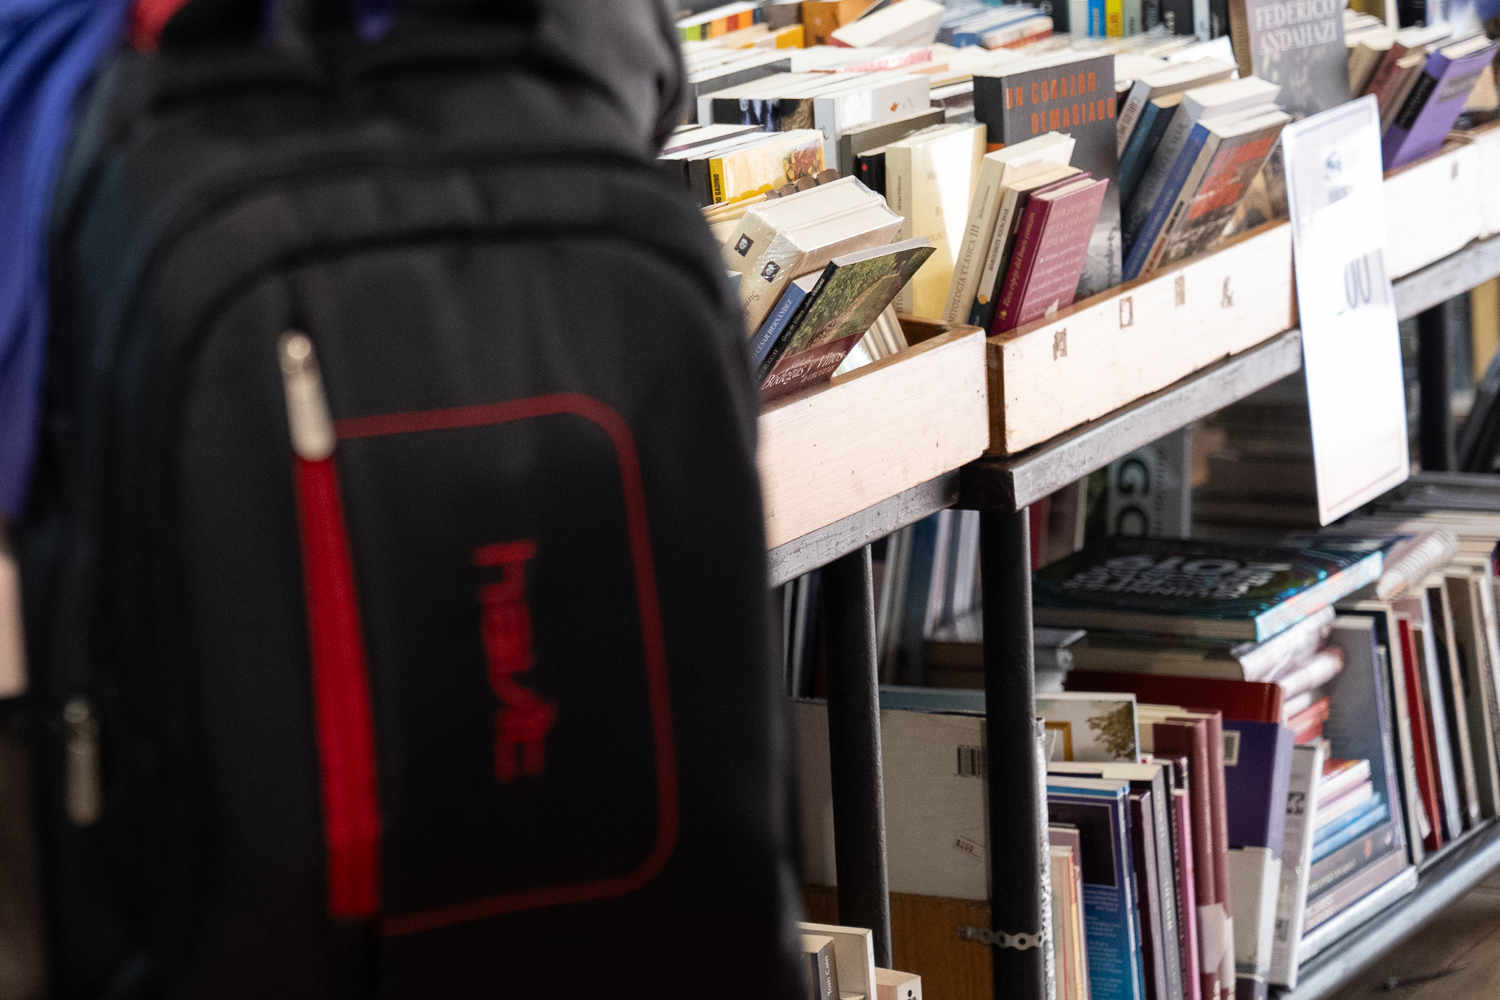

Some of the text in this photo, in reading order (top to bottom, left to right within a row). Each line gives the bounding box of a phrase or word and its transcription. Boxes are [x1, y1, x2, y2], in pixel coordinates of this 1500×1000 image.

[1260, 21, 1338, 53] ANDAHAZI
[1005, 70, 1096, 110] UN CORAZÓN
[1031, 96, 1115, 135] DEMASIADO
[961, 240, 978, 275] CLÁSICA
[970, 225, 980, 237] III
[1014, 257, 1023, 268] del
[1017, 239, 1027, 257] buen
[753, 333, 770, 354] CÉSAR
[765, 298, 793, 335] HERNÁNDEZ
[758, 348, 780, 374] URUGUAY
[782, 329, 791, 342] Greg
[811, 277, 826, 297] Vázquez
[760, 365, 808, 391] Bodegas
[817, 350, 846, 369] Vinos
[823, 955, 834, 996] Tom Cain
